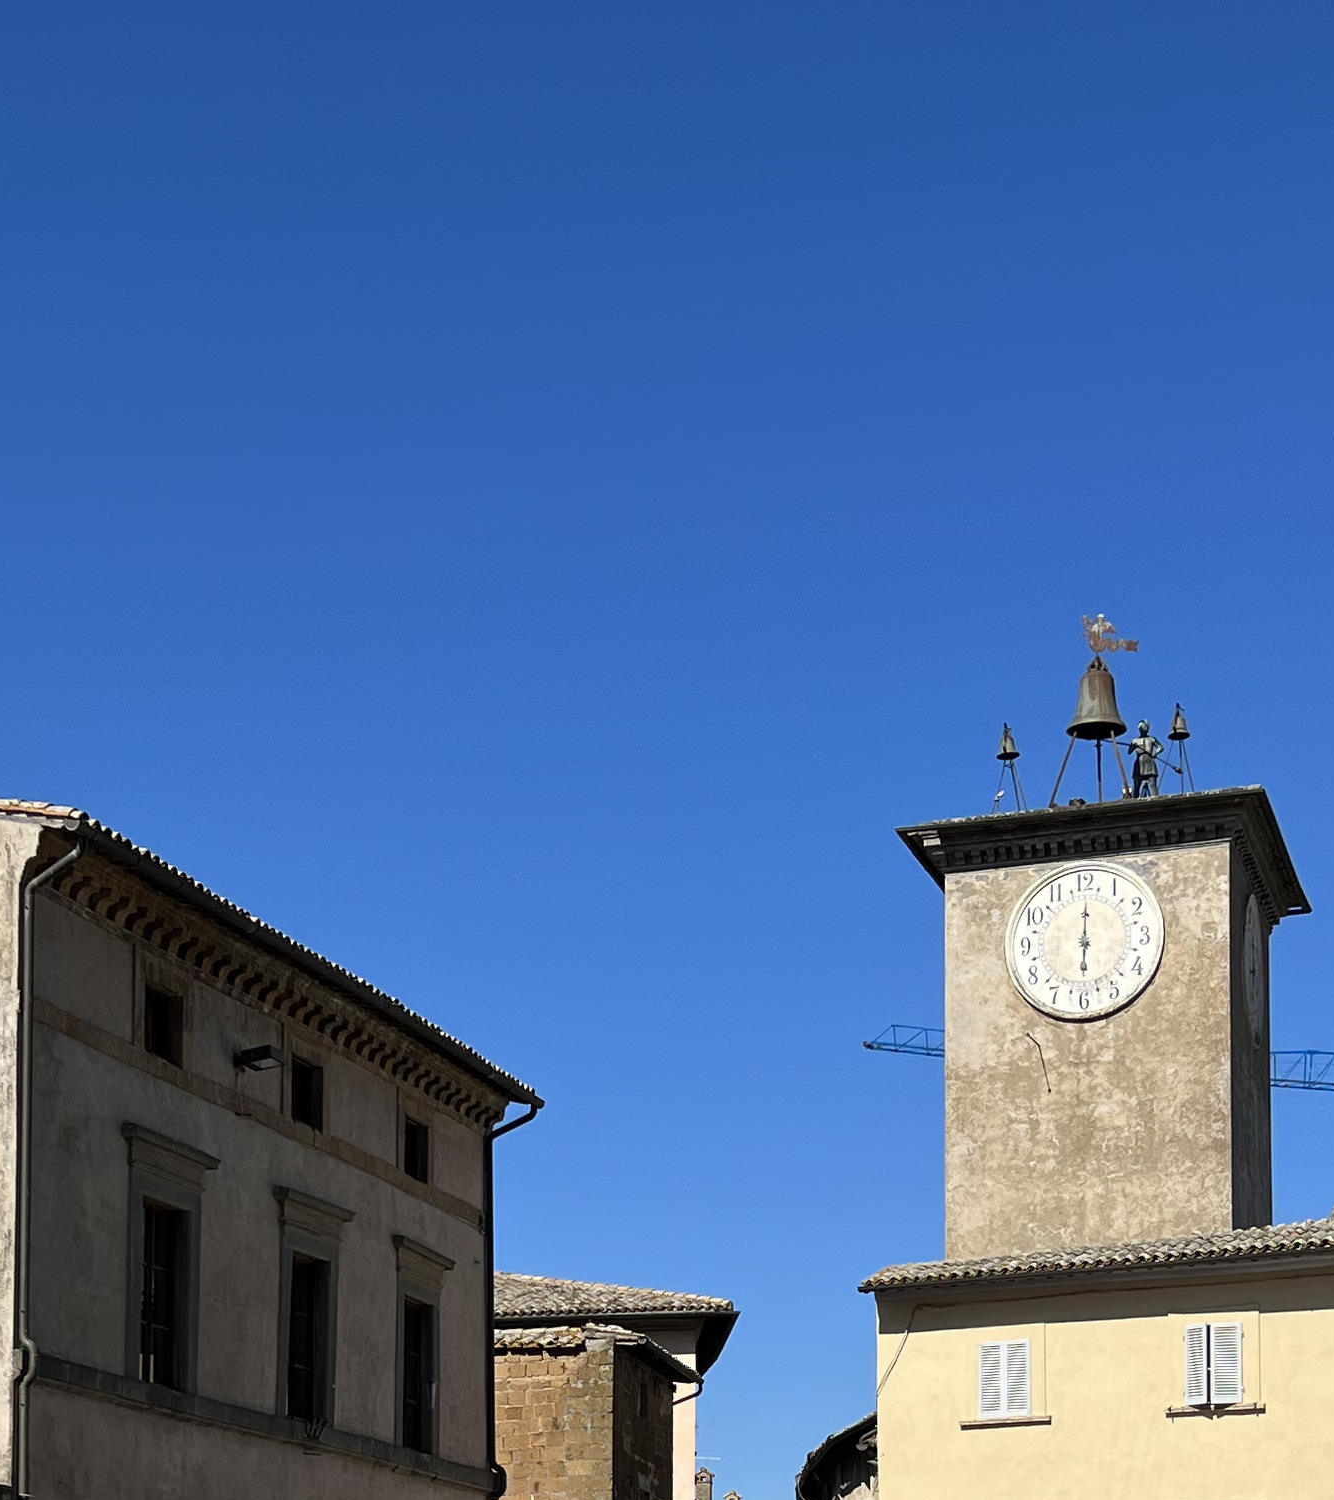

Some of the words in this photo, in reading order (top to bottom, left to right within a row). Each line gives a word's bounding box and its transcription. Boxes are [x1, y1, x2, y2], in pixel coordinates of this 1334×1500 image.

[1077, 873, 1094, 892] 12
[1112, 877, 1117, 897] 1
[1049, 883, 1063, 903] 11
[1026, 906, 1044, 926] 10
[1131, 897, 1143, 916] 2
[1139, 926, 1151, 945] 3
[1020, 936, 1031, 956] 9
[1028, 965, 1039, 985] 8
[1131, 956, 1144, 976] 4
[1049, 986, 1060, 1005] 7
[1109, 980, 1120, 1000] 5
[1079, 990, 1090, 1011] 6
